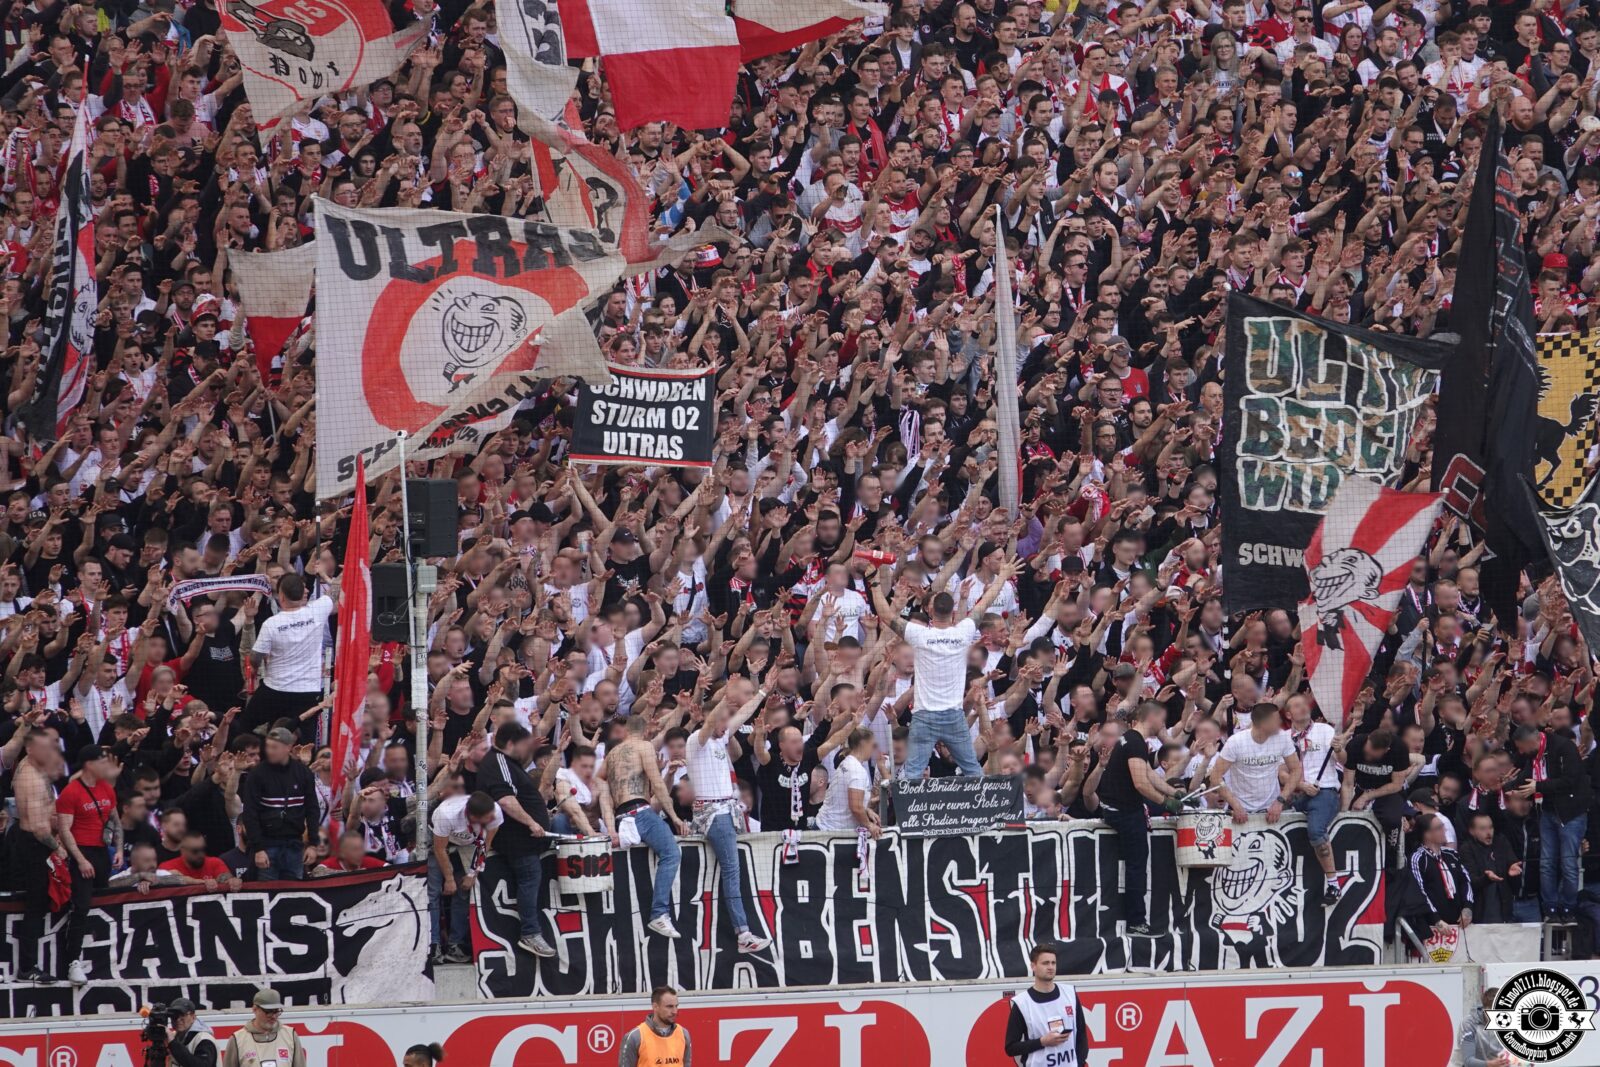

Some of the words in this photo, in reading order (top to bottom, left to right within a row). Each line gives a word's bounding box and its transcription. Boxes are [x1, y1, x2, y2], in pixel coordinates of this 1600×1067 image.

[590, 399, 666, 429] STURM
[671, 405, 700, 431] 02
[603, 431, 684, 460] ULTRAS
[1238, 542, 1304, 567] SCHW
[899, 779, 926, 795] Doch
[926, 778, 962, 793] Brüder
[963, 778, 981, 792] seid
[907, 799, 928, 813] dass
[929, 799, 946, 811] wir
[946, 801, 971, 810] euren
[972, 792, 999, 810] Stolz
[1000, 796, 1011, 807] in
[902, 814, 920, 829] alle
[921, 812, 959, 827] Stadien
[960, 814, 989, 829] tragen
